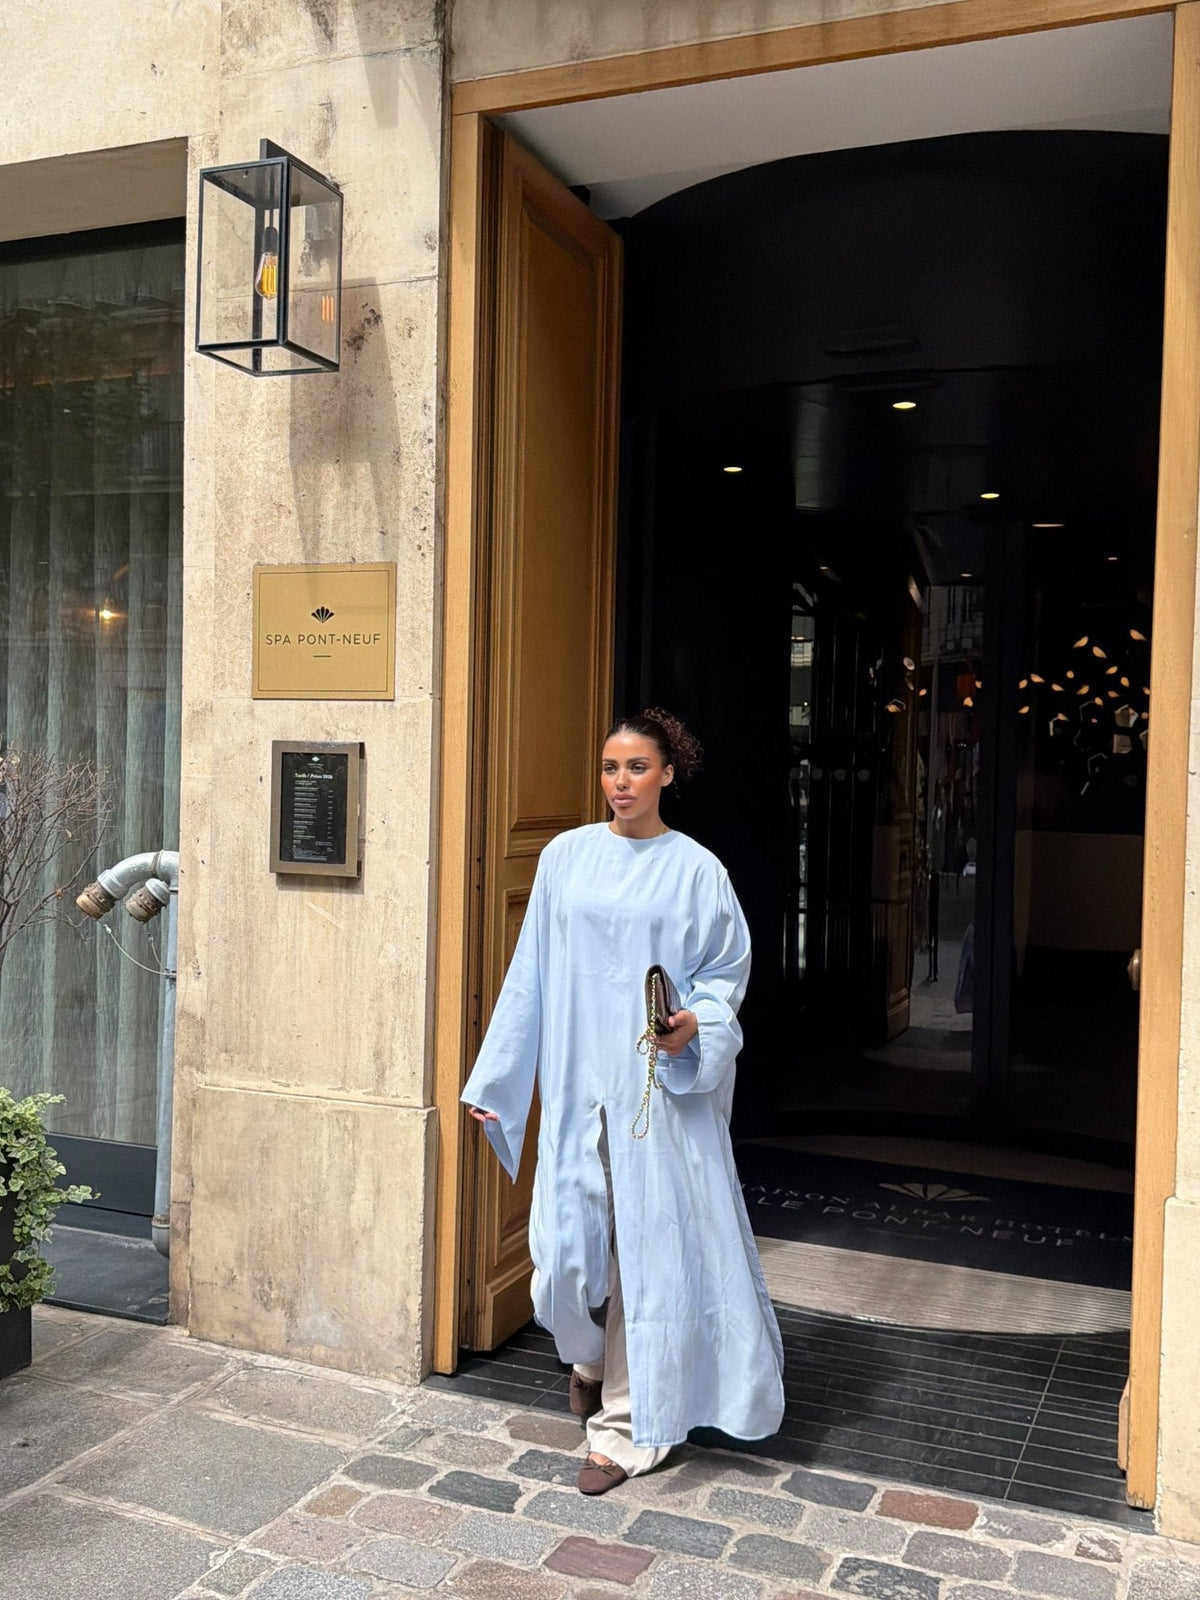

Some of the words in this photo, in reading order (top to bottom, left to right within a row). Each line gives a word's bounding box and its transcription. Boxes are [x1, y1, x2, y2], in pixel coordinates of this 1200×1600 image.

[265, 633, 291, 645] SPA
[298, 633, 381, 645] PONT-NEUF
[741, 1183, 850, 1204] AISON
[757, 1196, 804, 1210] LE
